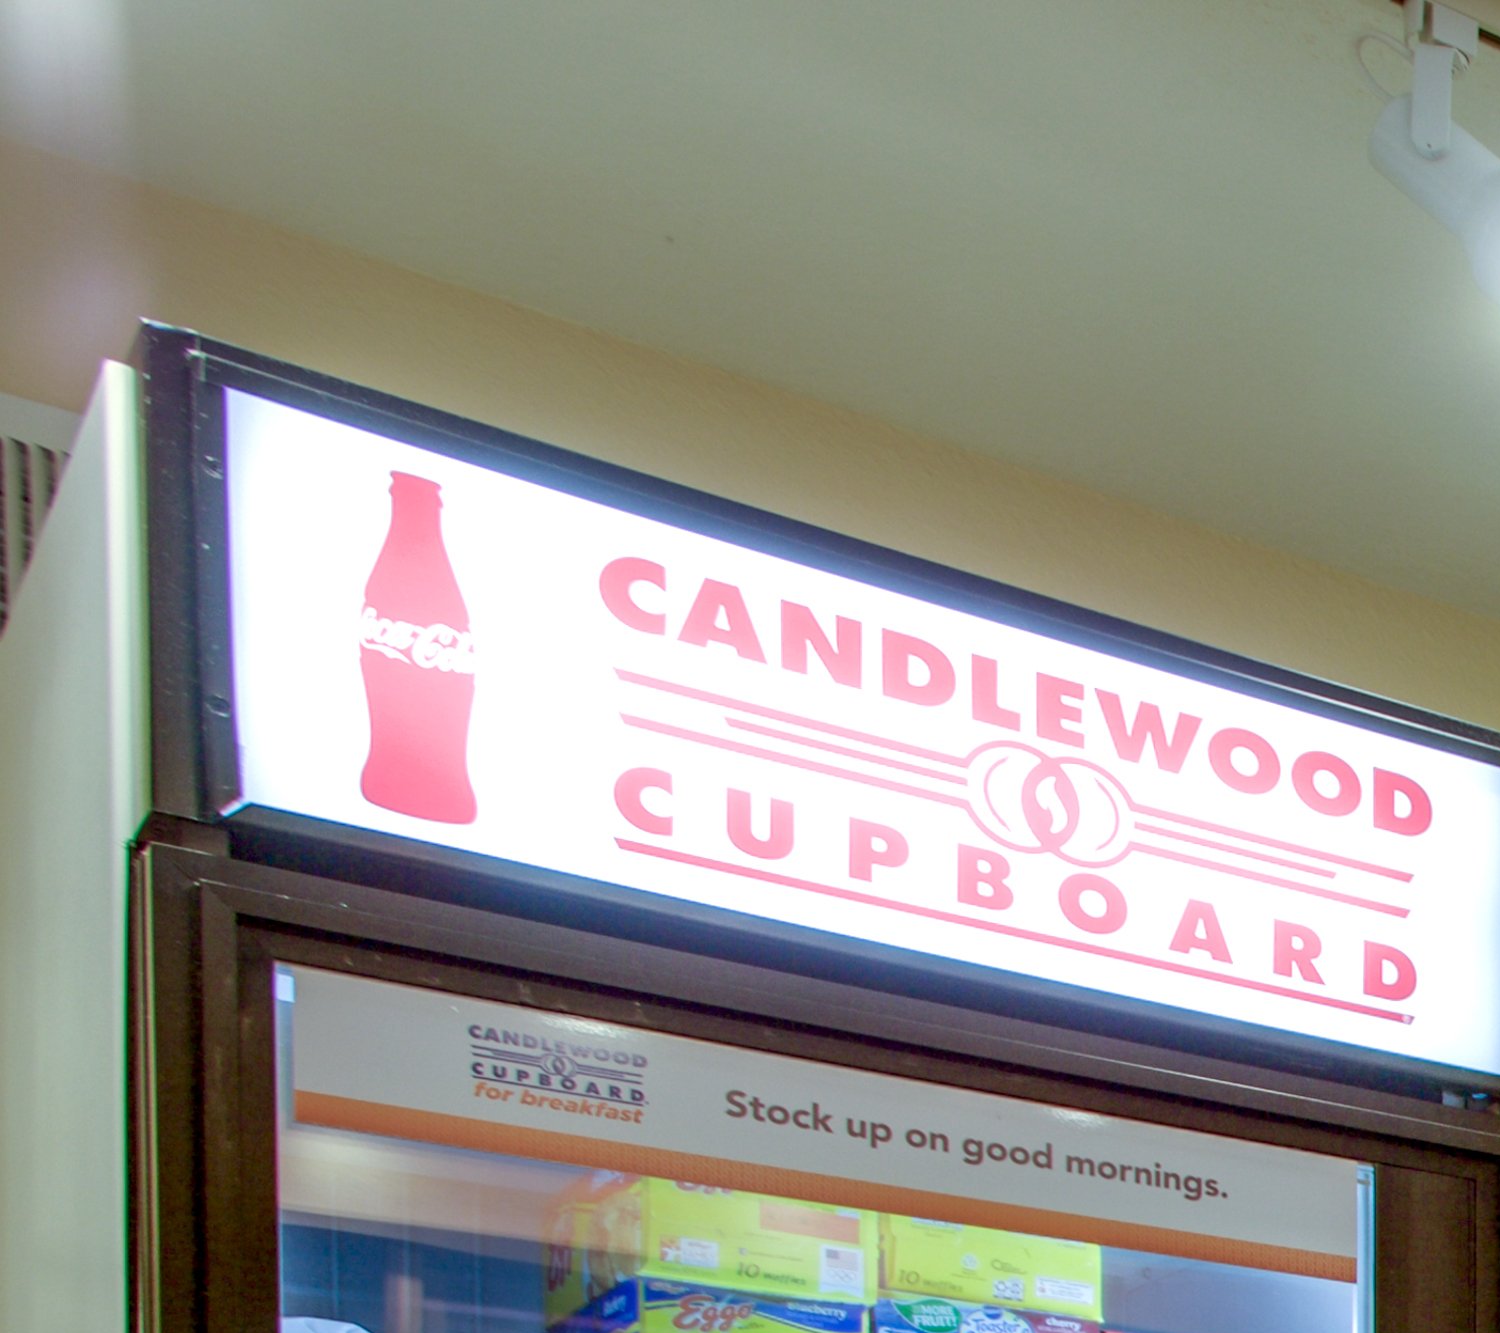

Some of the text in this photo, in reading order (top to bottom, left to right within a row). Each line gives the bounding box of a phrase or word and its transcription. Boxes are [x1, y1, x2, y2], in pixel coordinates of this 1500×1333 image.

[600, 556, 1434, 838] CANDLEWOOD
[612, 766, 1419, 1001] CUPBOARD
[468, 1024, 648, 1069] CANDLEWOOD
[470, 1062, 647, 1104] CUPBOARD
[473, 1081, 643, 1125] for breakfast
[725, 1089, 1228, 1200] Stock up on good mornings.
[672, 1294, 754, 1333] Eggo
[974, 1317, 1023, 1332] Toaster
